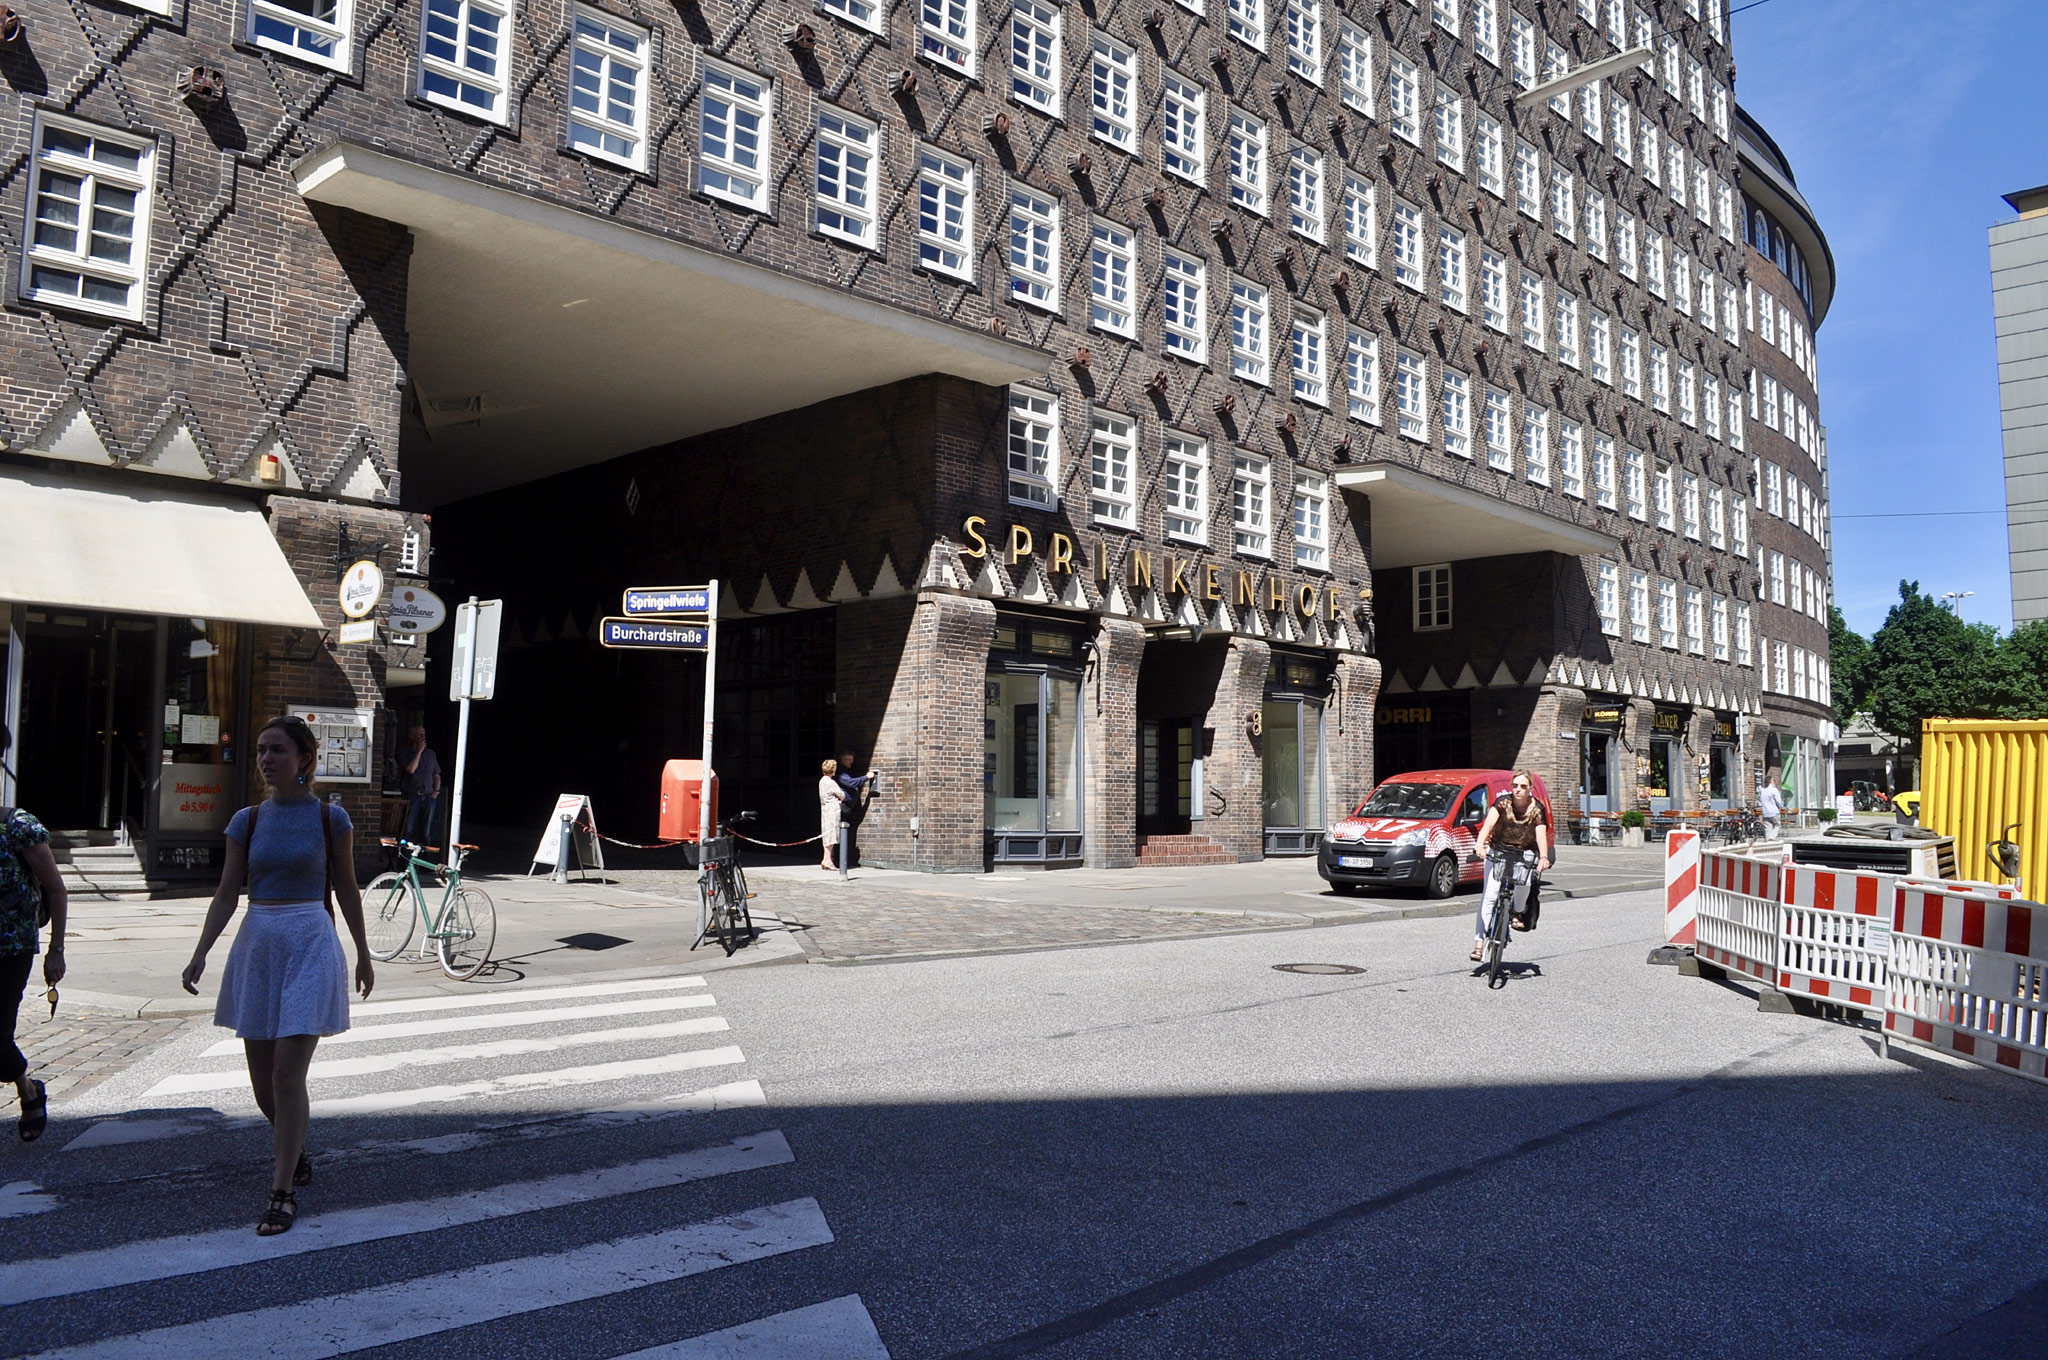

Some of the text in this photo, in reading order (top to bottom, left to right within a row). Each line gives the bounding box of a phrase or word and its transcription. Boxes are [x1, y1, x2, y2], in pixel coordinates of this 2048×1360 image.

[958, 515, 1341, 621] SPRINKENHOF
[630, 593, 706, 611] Springeltwiete
[406, 604, 435, 616] Pilsener
[611, 625, 702, 643] Burchardstraße
[175, 782, 221, 797] Mittagstisch
[180, 801, 190, 812] ab
[191, 802, 208, 813] 5,90
[1370, 819, 1421, 833] 17
